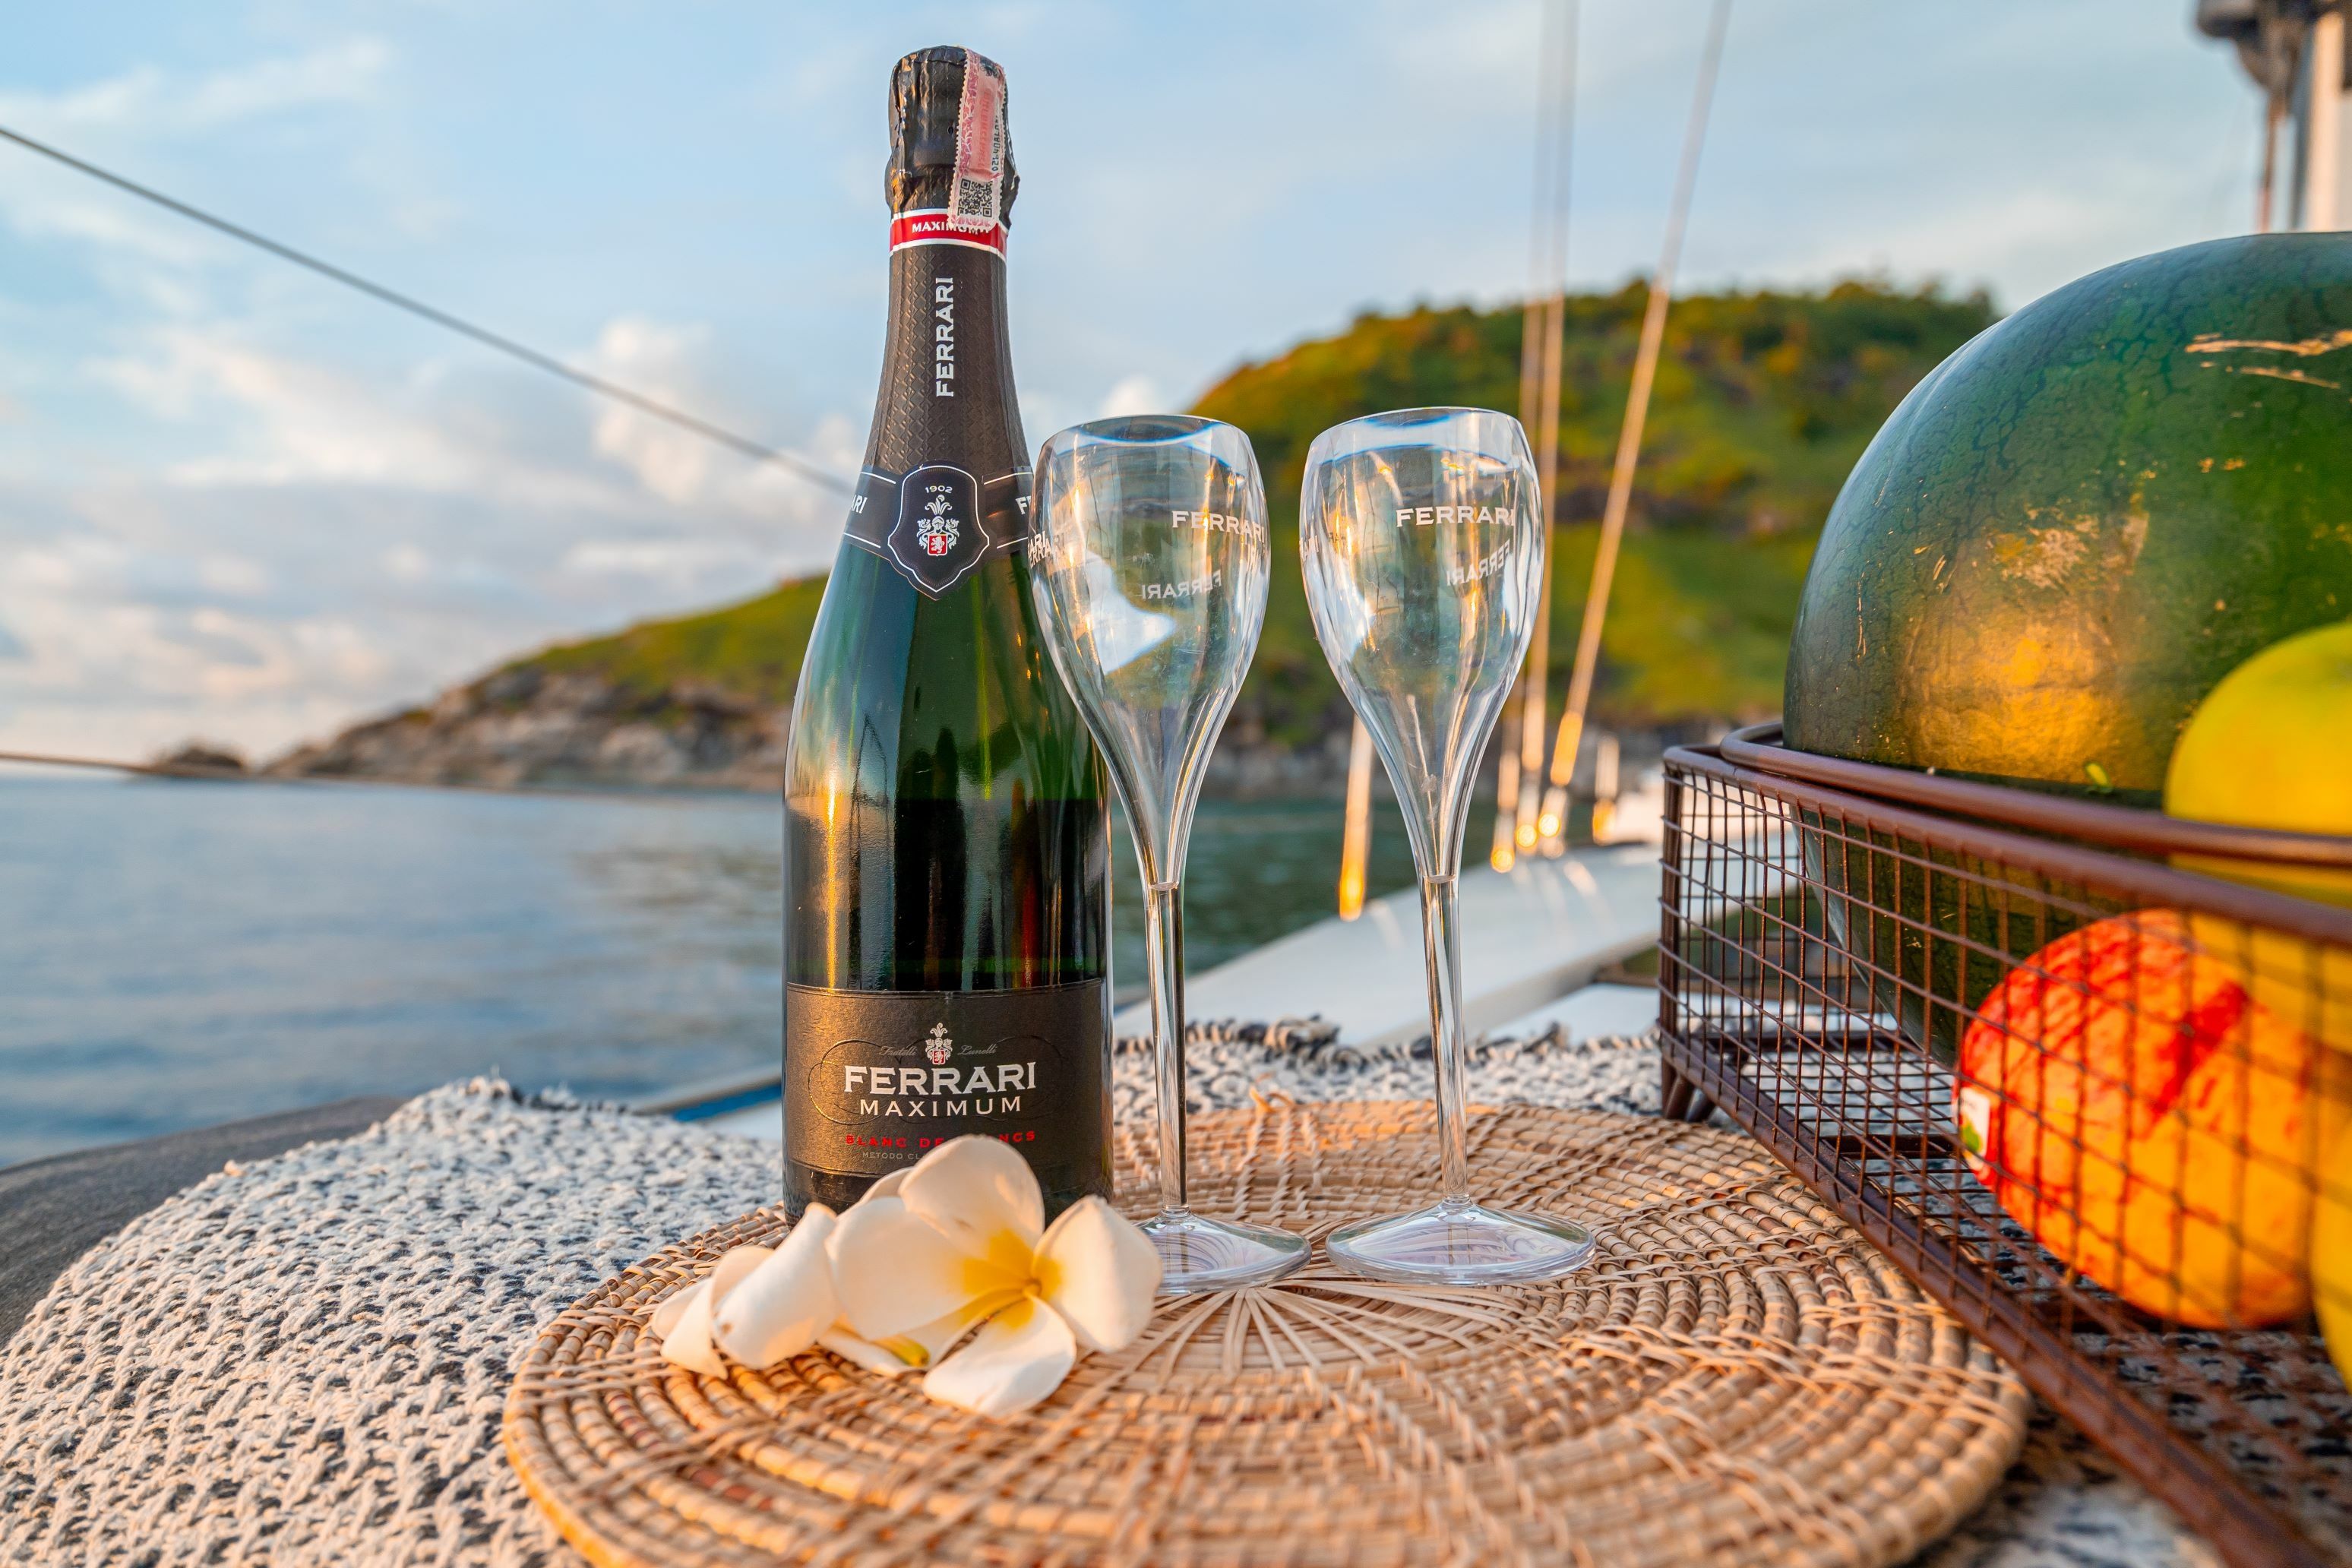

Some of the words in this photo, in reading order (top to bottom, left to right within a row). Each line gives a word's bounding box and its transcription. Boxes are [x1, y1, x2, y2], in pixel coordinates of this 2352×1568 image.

[935, 277, 954, 397] FERRARI
[925, 485, 953, 494] 1902
[1171, 510, 1265, 543] FERRARI
[1396, 505, 1516, 527] FERRARI
[957, 1044, 998, 1056] Lunelli
[844, 1061, 1036, 1095] FERRARI
[860, 1096, 1021, 1118] MAXIMUM
[846, 1134, 907, 1149] BLANC
[862, 1151, 903, 1160] METODO
